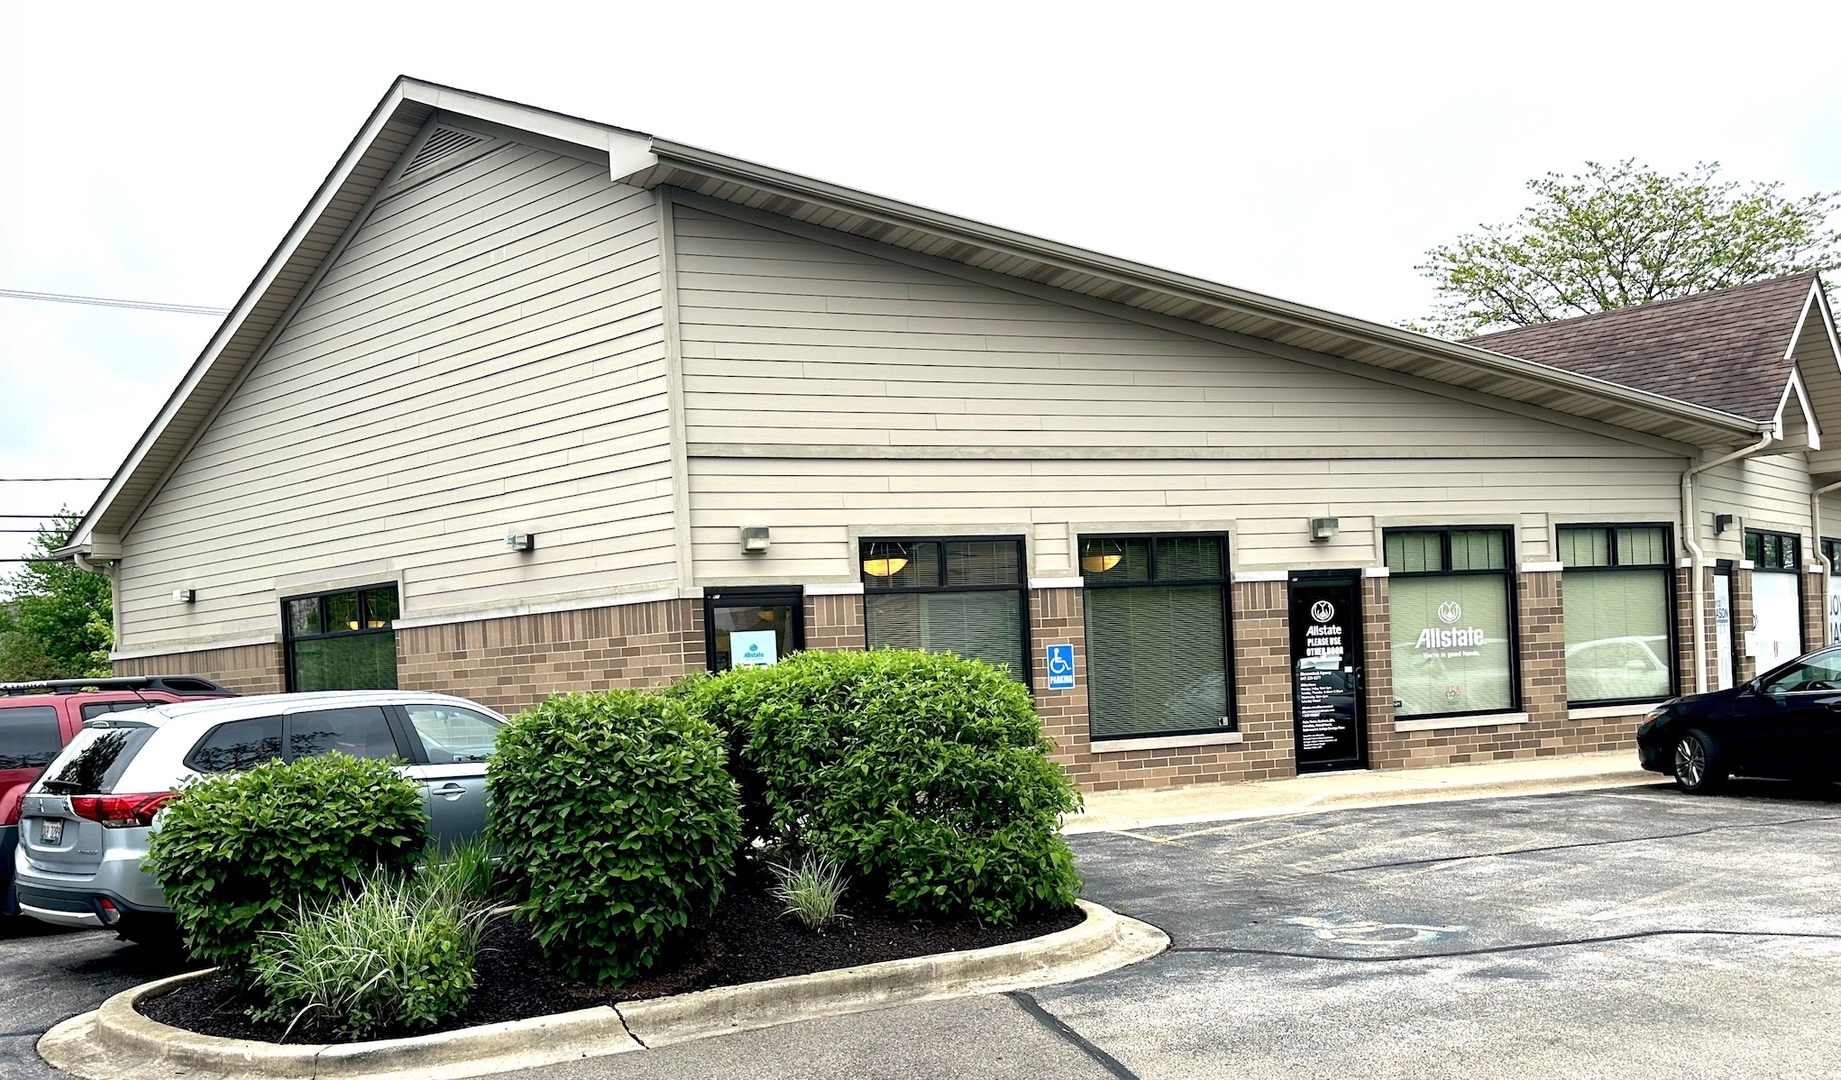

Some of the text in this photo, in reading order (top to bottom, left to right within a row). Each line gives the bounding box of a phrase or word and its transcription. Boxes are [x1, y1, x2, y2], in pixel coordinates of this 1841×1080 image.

[1306, 624, 1343, 636] Allstate
[1307, 636, 1342, 647] PLEASE USE
[1326, 646, 1344, 655] DOOR
[1448, 650, 1462, 658] good
[1050, 675, 1073, 684] PARKING
